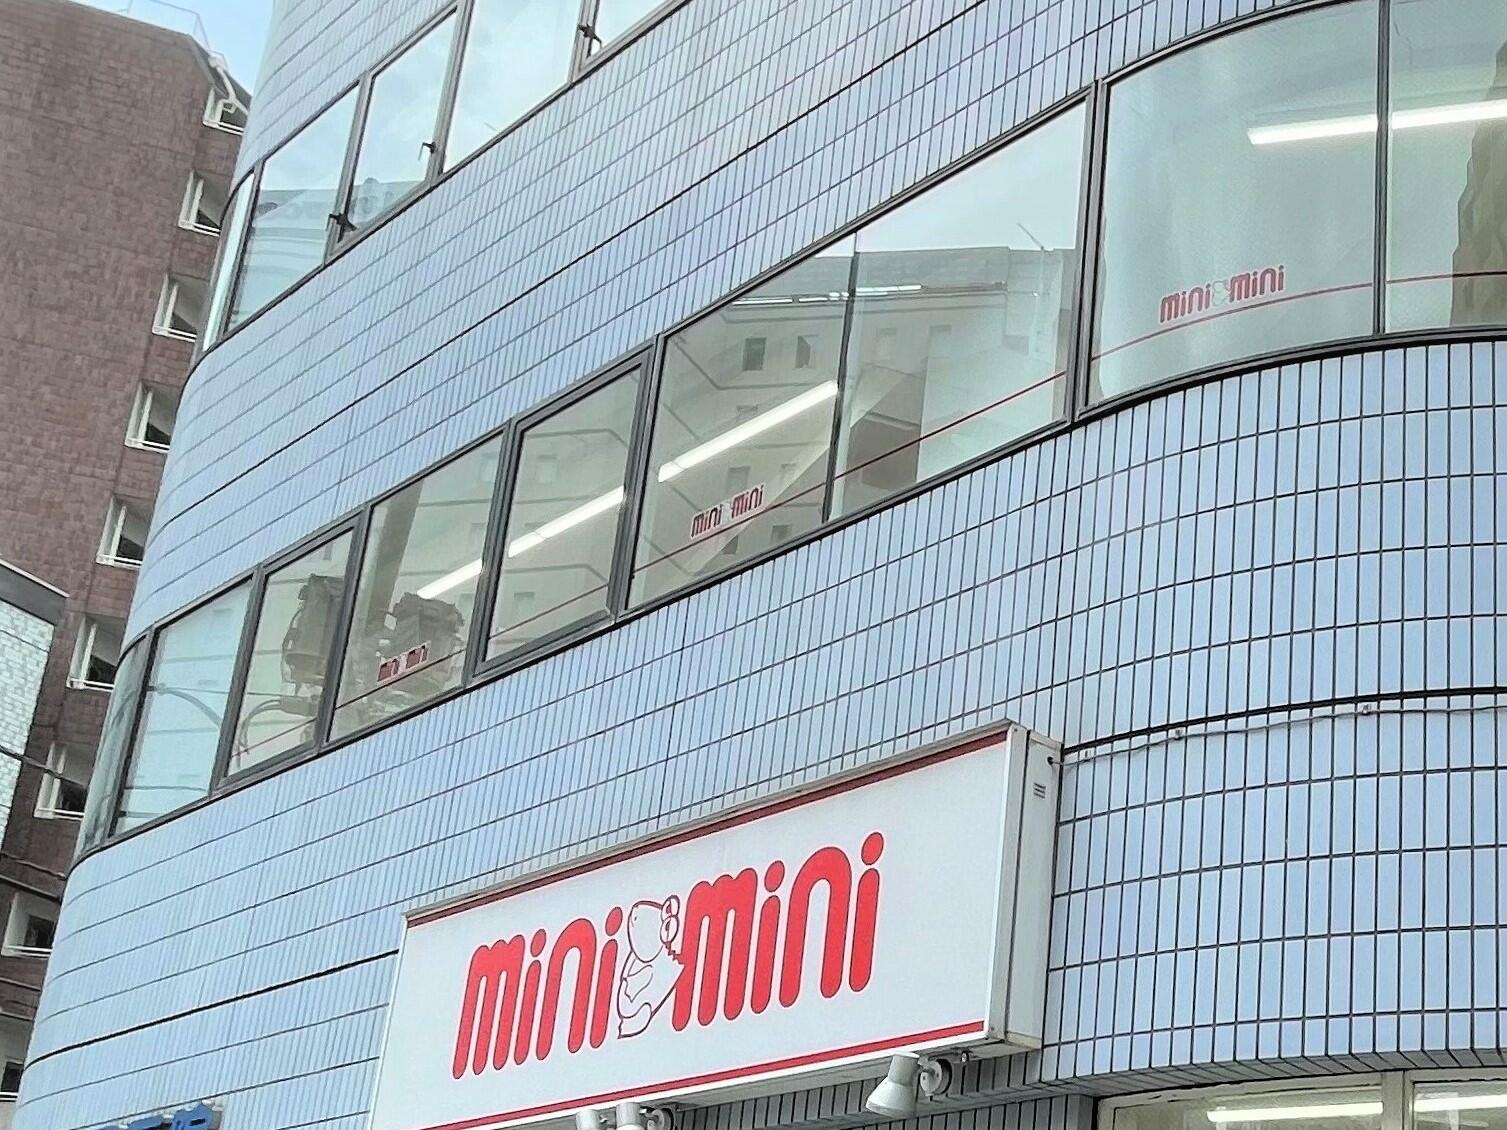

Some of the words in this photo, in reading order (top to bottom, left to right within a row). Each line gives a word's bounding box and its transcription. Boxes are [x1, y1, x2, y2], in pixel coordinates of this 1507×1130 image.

[1160, 283, 1211, 323] mini
[1229, 265, 1284, 303] mini
[691, 503, 723, 538] mini
[731, 484, 764, 519] mini
[451, 905, 623, 1080] mini
[672, 830, 885, 1032] mini
